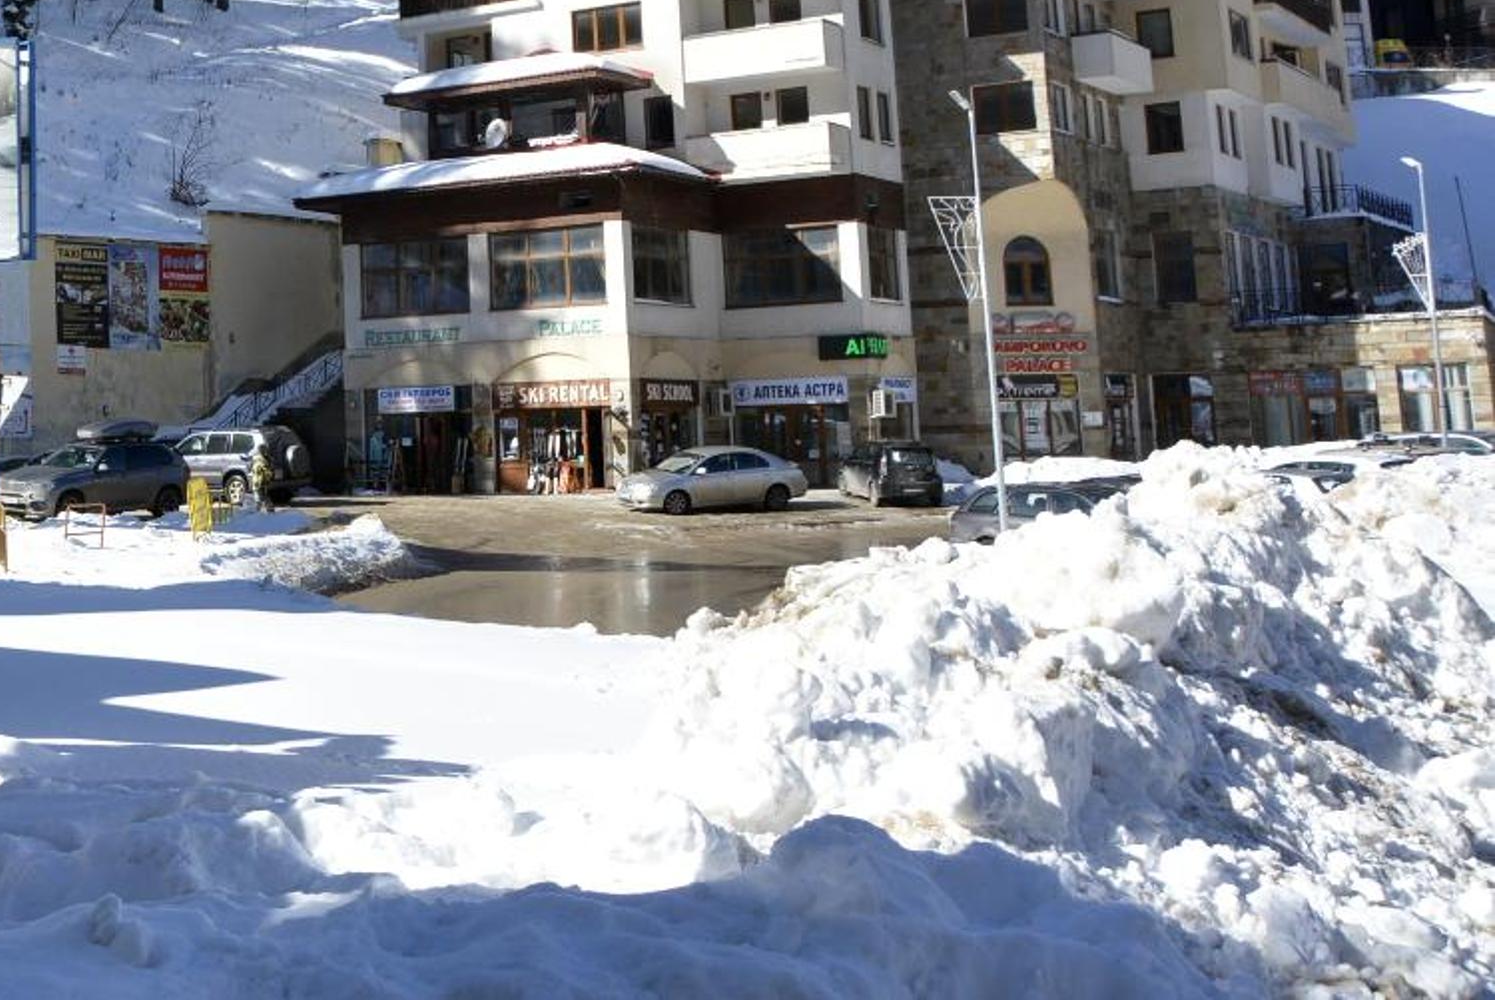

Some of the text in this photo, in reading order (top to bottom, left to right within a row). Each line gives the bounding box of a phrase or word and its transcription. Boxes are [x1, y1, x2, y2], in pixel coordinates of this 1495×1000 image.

[519, 386, 545, 403] SKI
[548, 383, 609, 402] RENTAL
[753, 382, 844, 399] АПТЕКА АСТРА
